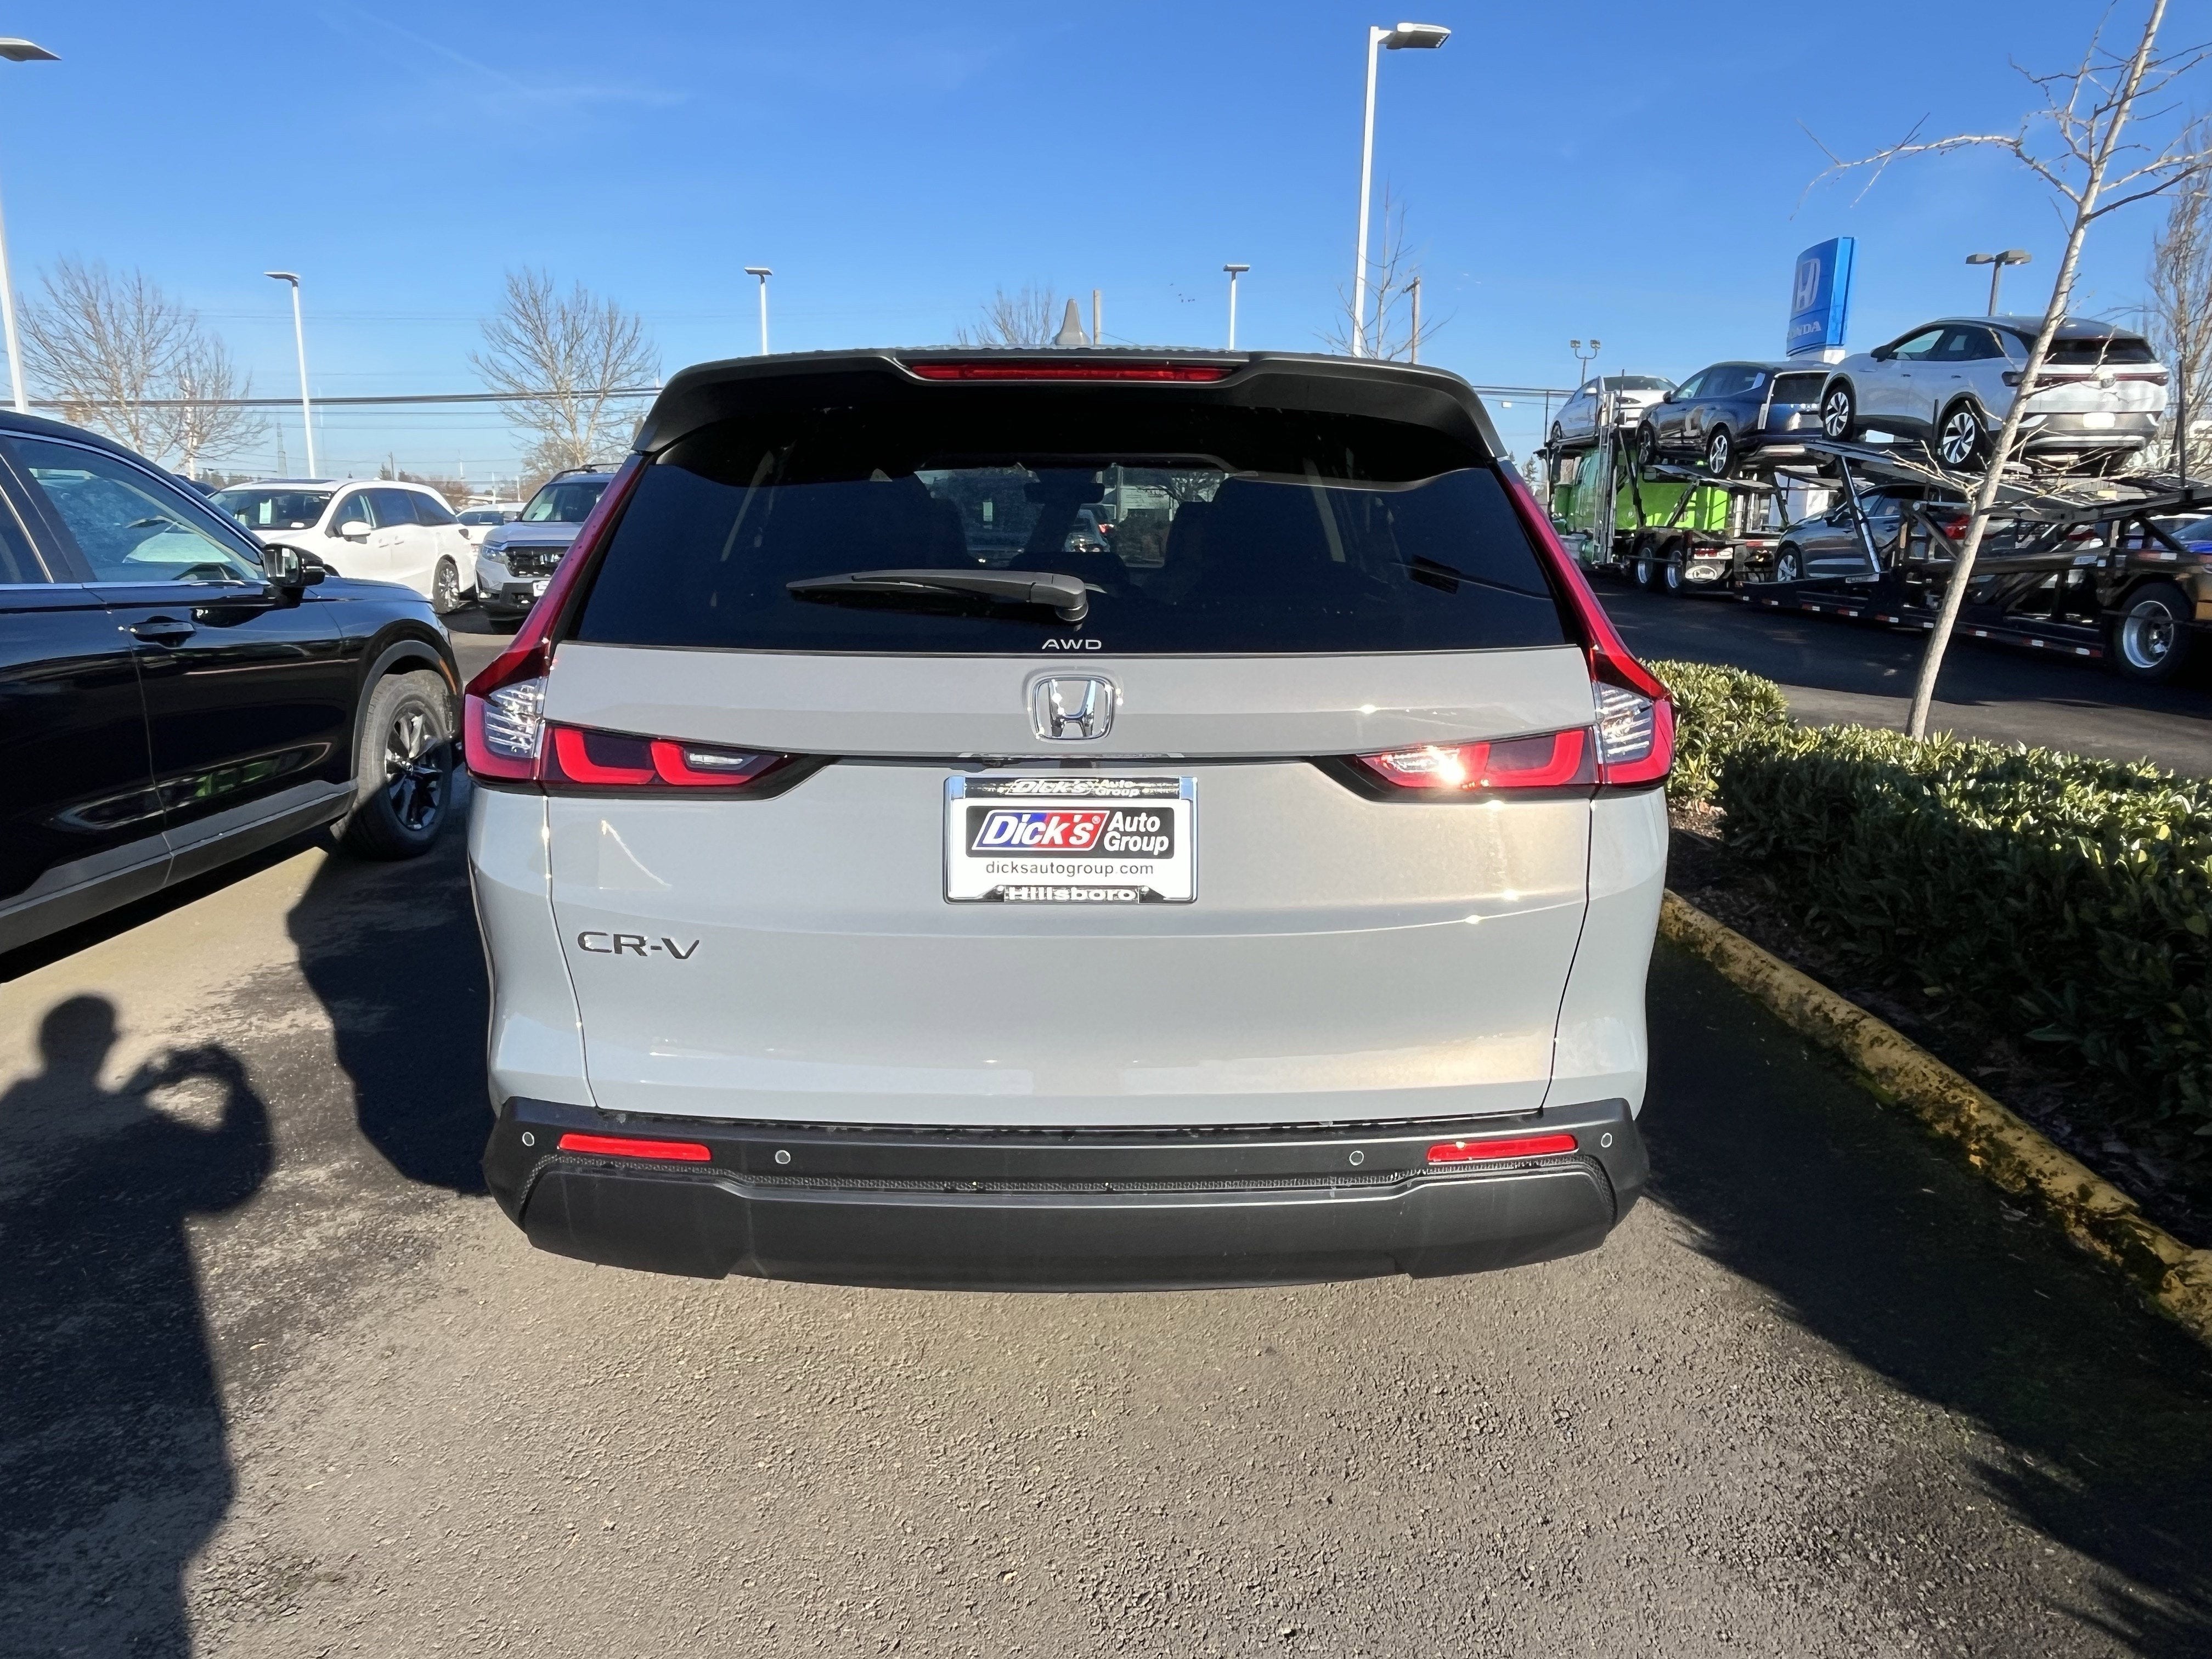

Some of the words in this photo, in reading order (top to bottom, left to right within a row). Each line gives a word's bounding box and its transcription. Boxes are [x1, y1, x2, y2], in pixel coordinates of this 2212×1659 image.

[1042, 639, 1102, 650] AWD
[1101, 779, 1134, 788] Auto
[1095, 788, 1140, 797] Group
[983, 814, 1092, 845] Dick's
[1107, 811, 1160, 832] Auto
[1104, 832, 1169, 855] Group
[986, 862, 1153, 877] dicksautogroup.com
[1009, 887, 1136, 901] Hillsboro
[578, 932, 699, 960] CR-V
